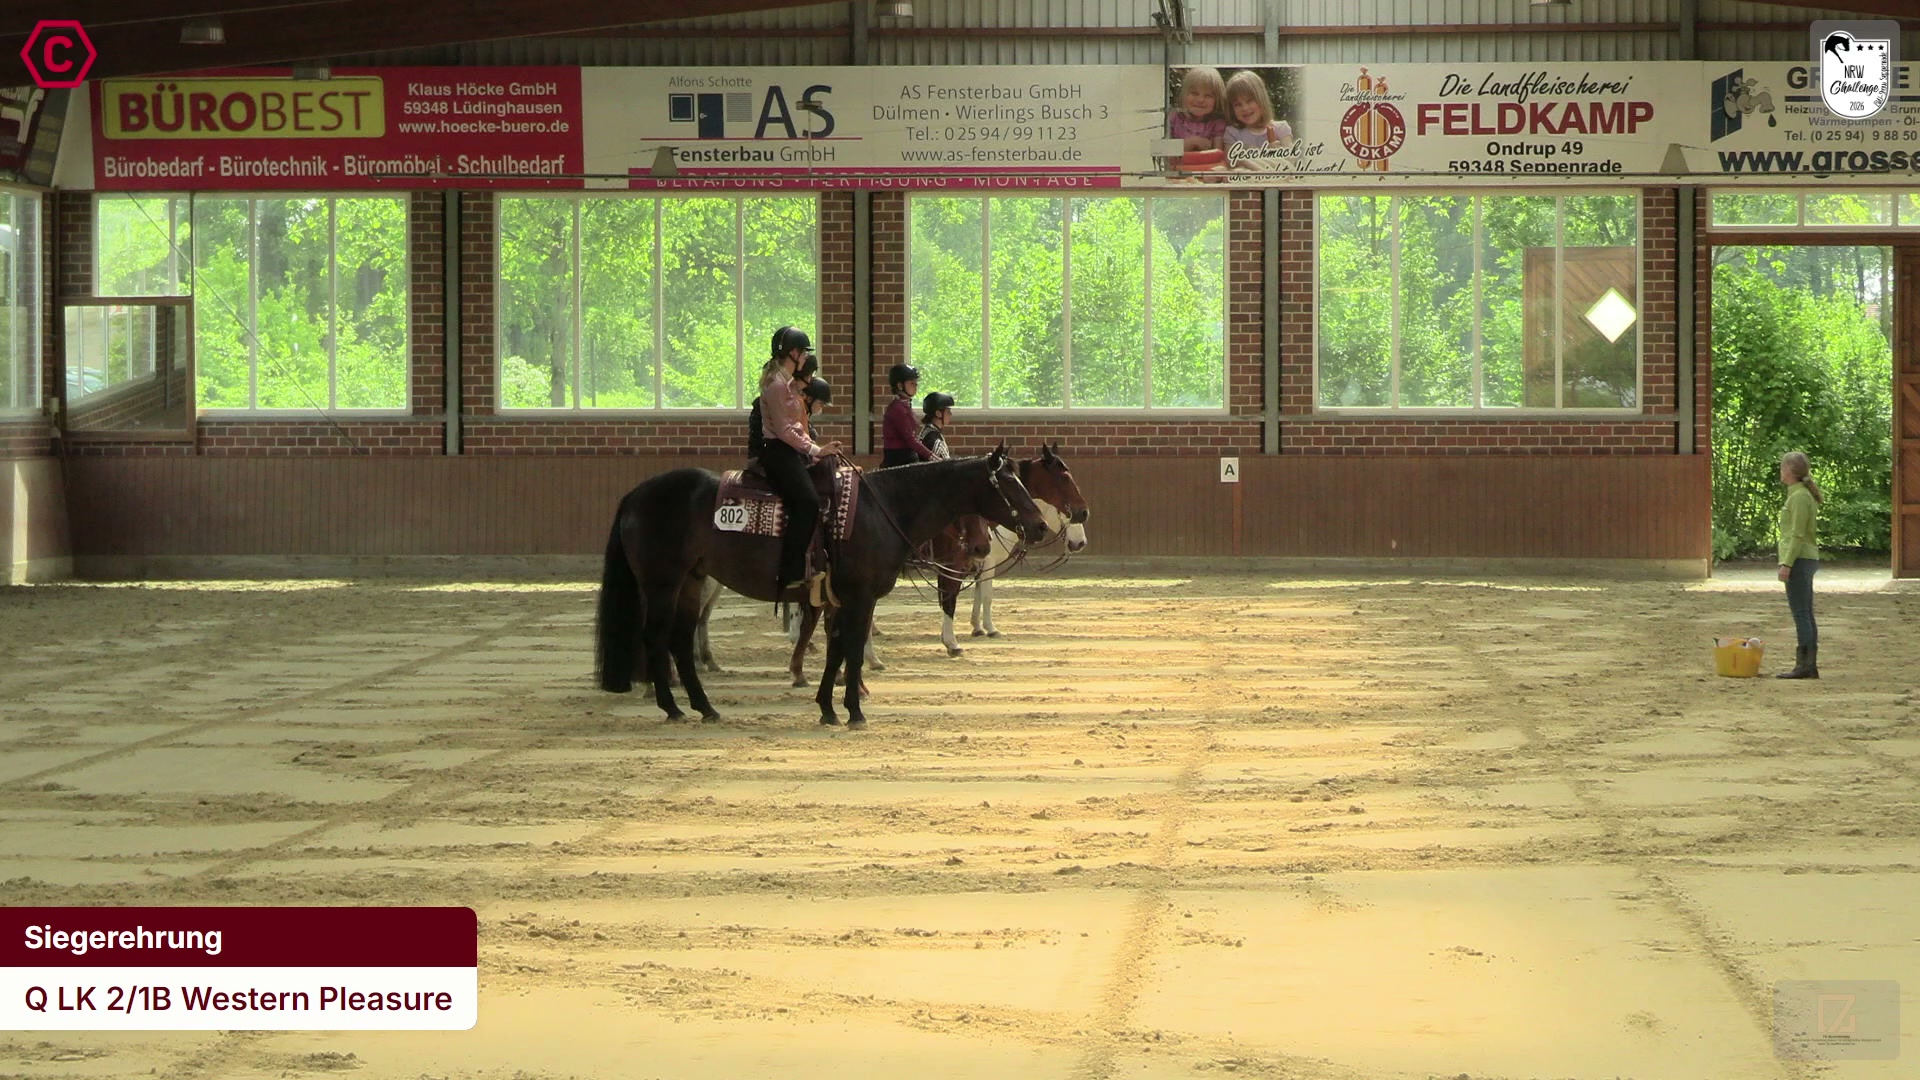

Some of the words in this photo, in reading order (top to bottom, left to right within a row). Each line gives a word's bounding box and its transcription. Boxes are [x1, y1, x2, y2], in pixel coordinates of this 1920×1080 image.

[408, 83, 451, 96] Klaus
[456, 82, 504, 96] Höcke
[509, 82, 557, 96] GmbH
[669, 77, 704, 87] Alfons
[708, 76, 752, 87] Schotte
[1439, 73, 1473, 97] Die
[1478, 71, 1633, 104] Landfleischerei
[901, 85, 921, 100] AS
[928, 84, 1022, 100] Fensterbau
[1029, 84, 1082, 100] GmbH
[119, 83, 371, 132] BÜROBEST
[403, 102, 448, 114] 59348
[453, 101, 563, 117] Lüdinghausen
[754, 85, 835, 139] AS
[873, 105, 940, 121] Dülmen
[956, 105, 1035, 124] Wierlings
[1042, 105, 1092, 120] Busch
[1100, 105, 1108, 120] 3
[398, 120, 569, 133] www.hoecke-buero.de
[1416, 101, 1655, 136] FELDKAMP
[1809, 116, 1892, 129] Wärmepumpen
[906, 127, 939, 141] Tel.:
[1784, 131, 1806, 141] Tel.
[1810, 131, 1823, 143] (0
[1826, 131, 1842, 141] 25
[1845, 131, 1865, 143] 94)
[1872, 131, 1880, 141] 9
[1884, 131, 1899, 141] 88
[1903, 131, 1918, 141] 50
[1343, 126, 1404, 159] FELDKAMP
[1486, 141, 1556, 158] Ondrup
[1561, 141, 1583, 155] 49
[670, 146, 774, 162] Fensterbau
[780, 146, 835, 162] GmbH
[901, 147, 1082, 162] www.as-fensterbau.de
[1229, 139, 1301, 166] Geschmack
[1305, 142, 1324, 156] ist
[104, 156, 203, 178] Bürobedarf
[220, 156, 327, 177] Bürotechnik
[344, 155, 441, 176] Büromöbel
[457, 154, 565, 175] Schulbedarf
[1448, 160, 1505, 173] 59348
[1510, 159, 1623, 173] Seppenrade
[1224, 463, 1235, 476] A
[720, 508, 743, 523] 802
